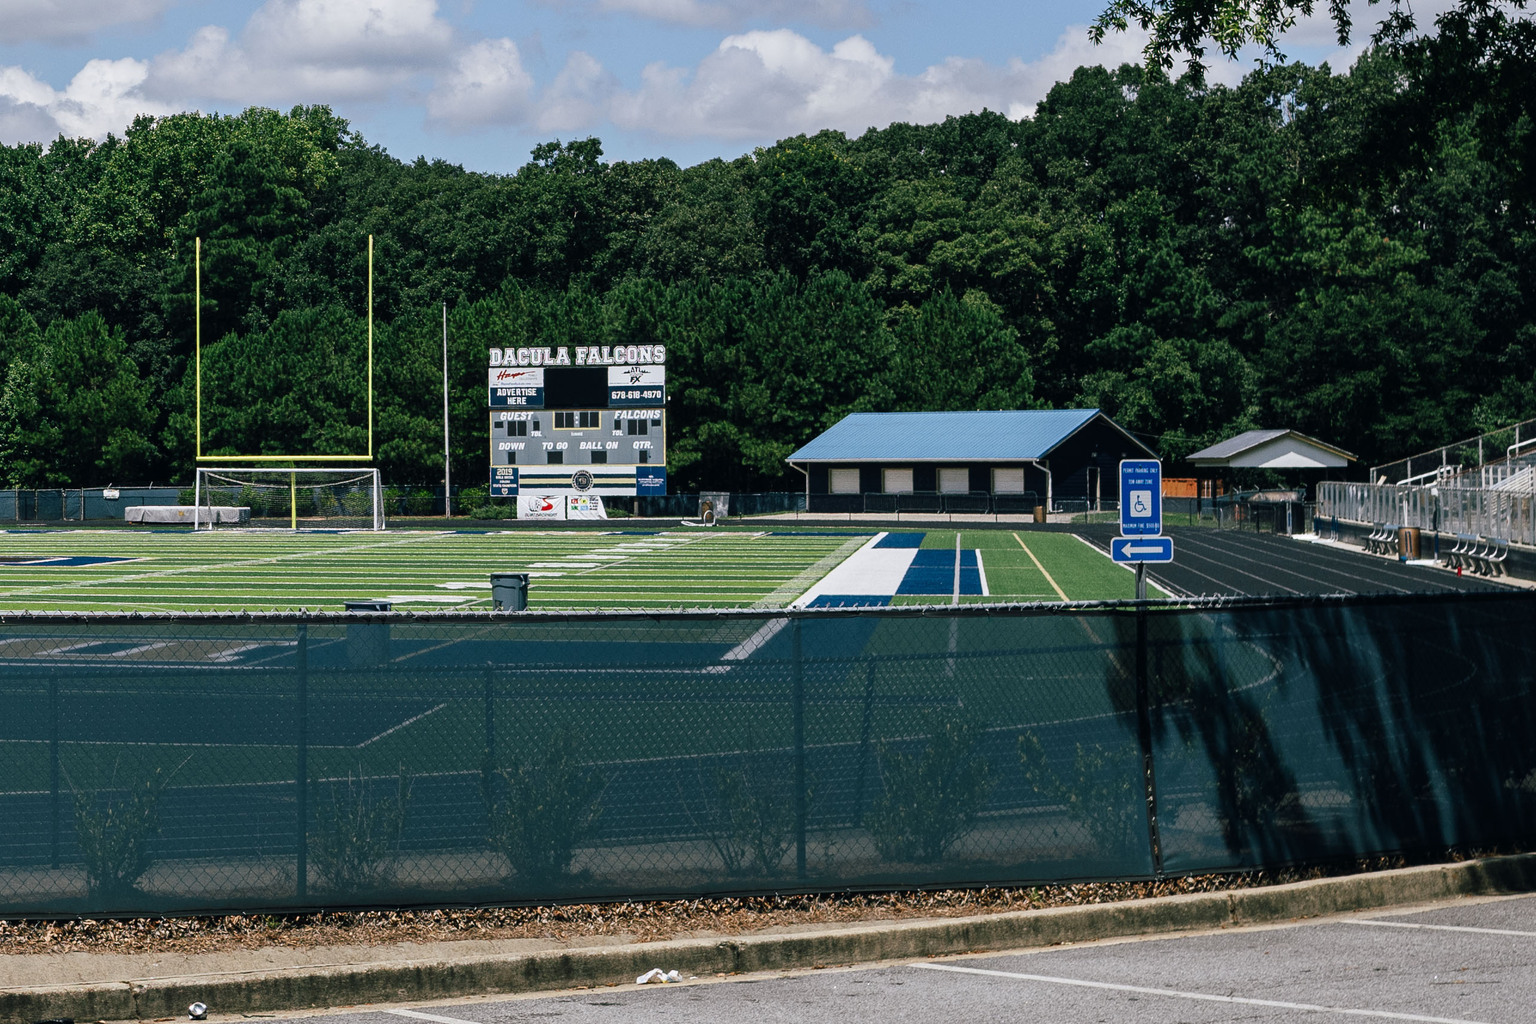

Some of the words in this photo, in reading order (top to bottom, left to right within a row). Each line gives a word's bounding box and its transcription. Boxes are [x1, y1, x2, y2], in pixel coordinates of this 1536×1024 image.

[489, 347, 571, 366] DACULA
[575, 345, 666, 365] FALCONS
[497, 388, 537, 396] ADVERTISE
[611, 391, 662, 400] 678-618-4970
[500, 412, 534, 420] GUEST
[614, 410, 661, 419] FALCONS
[498, 442, 525, 450] DOWN
[542, 442, 553, 450] TO
[556, 442, 568, 450] GO
[579, 441, 602, 450] BALL
[605, 441, 618, 450] ON
[632, 440, 654, 449] QTR.
